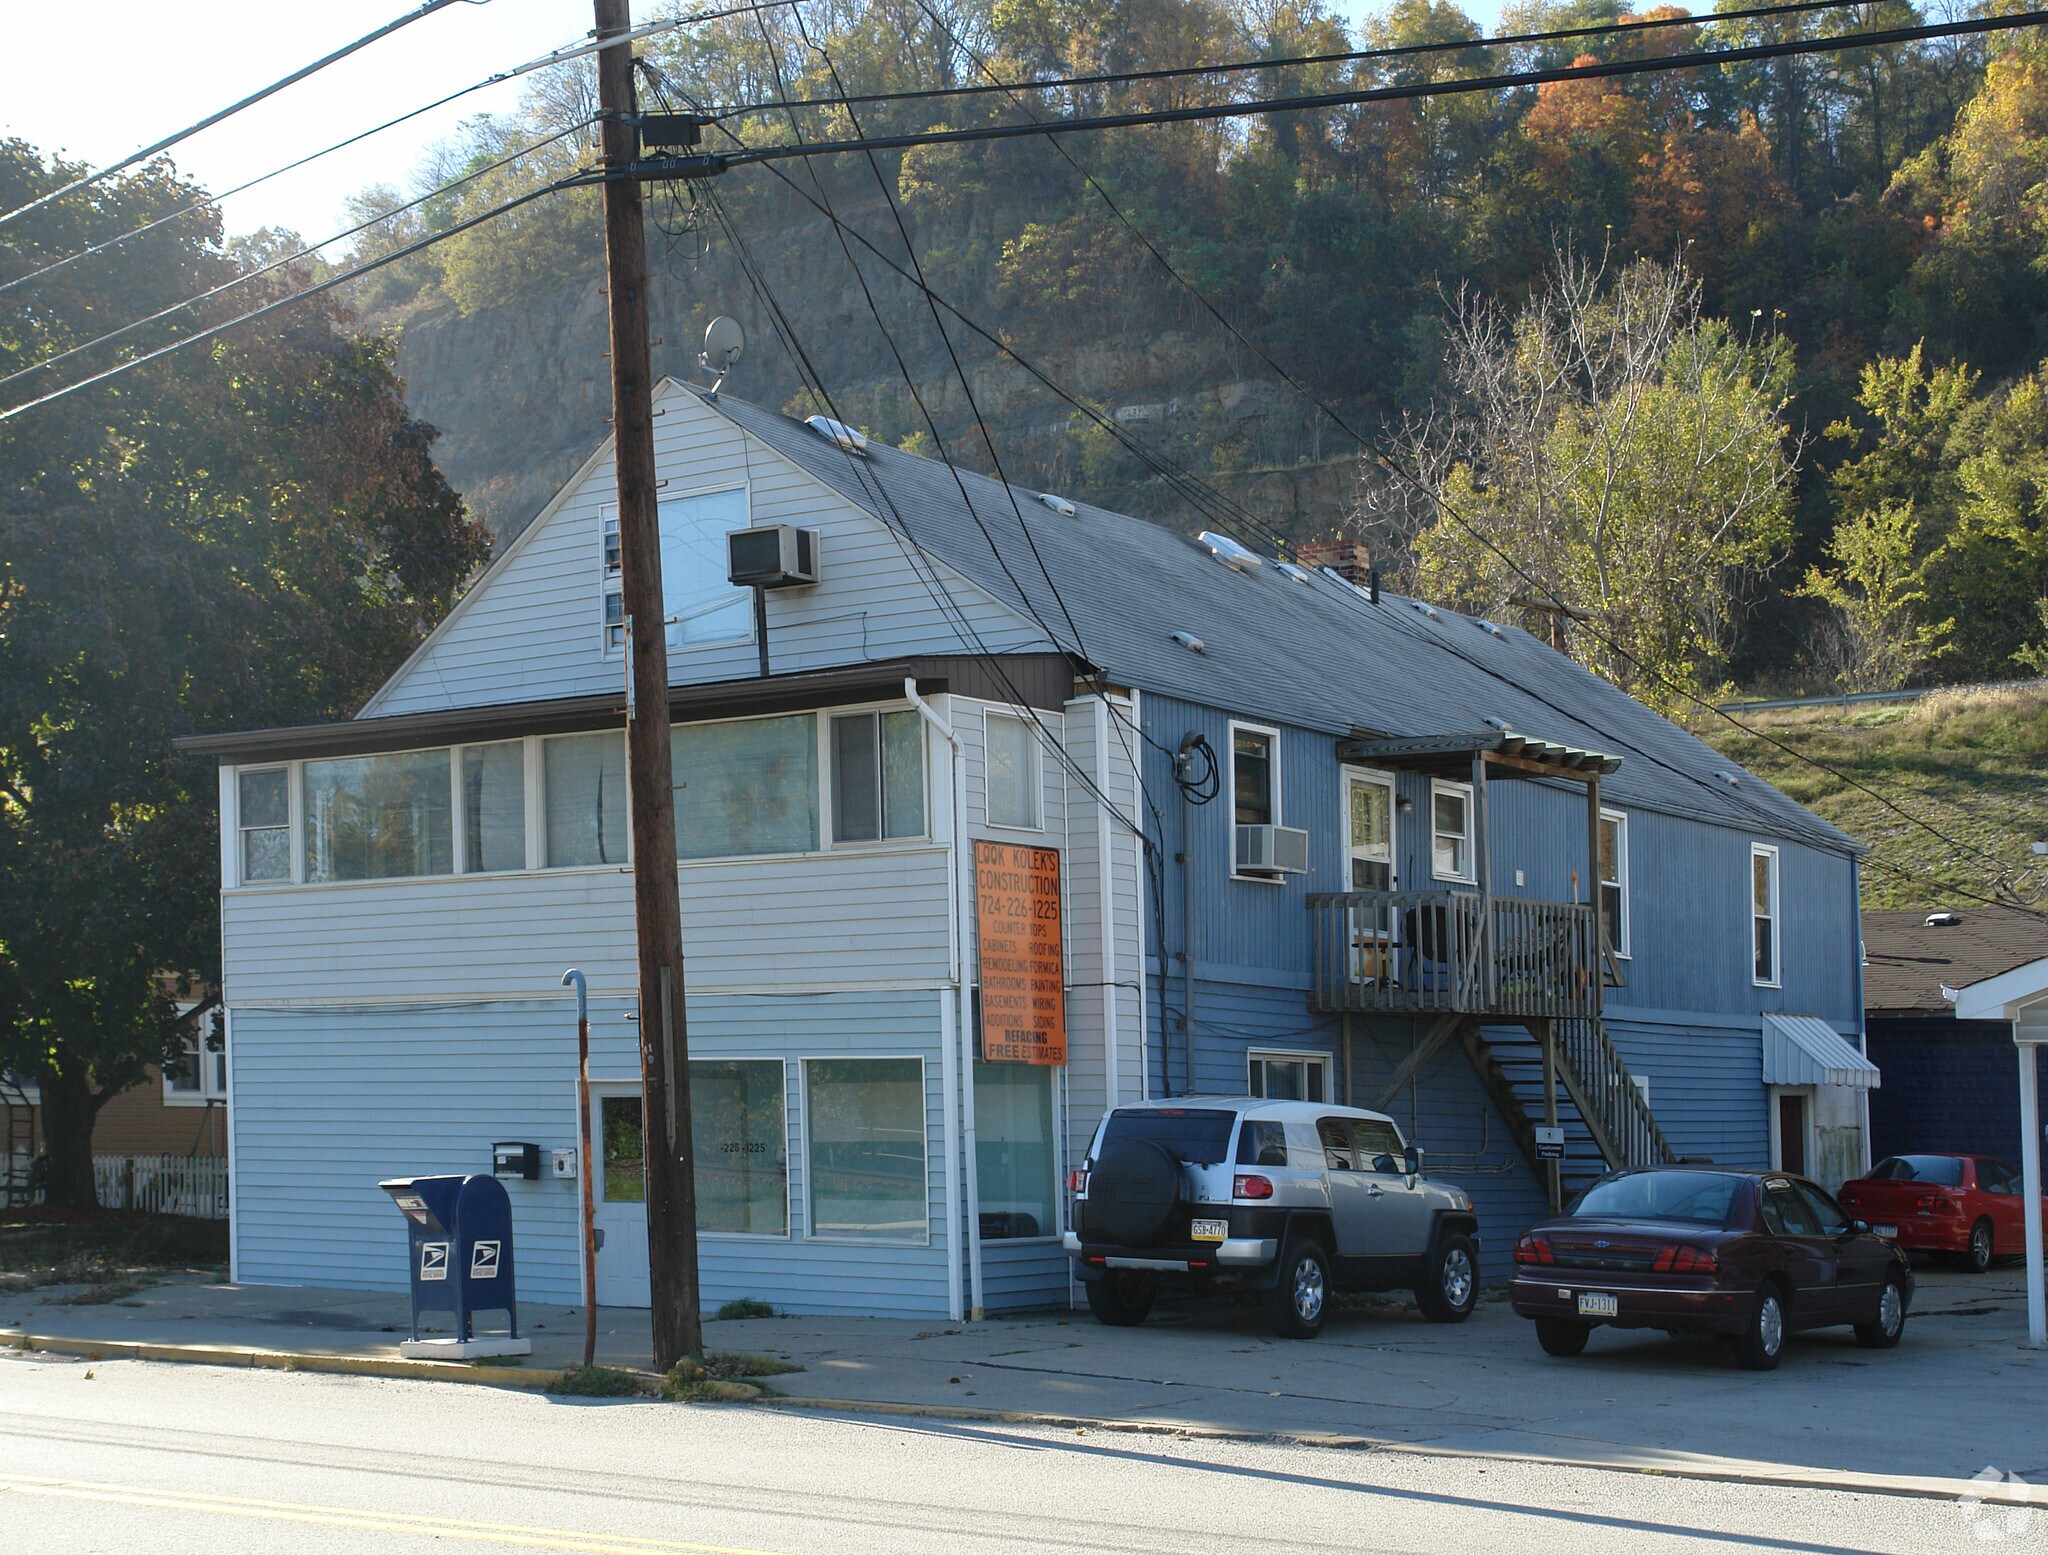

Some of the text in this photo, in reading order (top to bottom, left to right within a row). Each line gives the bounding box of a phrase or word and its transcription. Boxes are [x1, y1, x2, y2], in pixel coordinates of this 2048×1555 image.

[977, 845, 1056, 872] LOOK KOLEK'S
[979, 869, 1058, 896] CONSTRUCTION
[980, 894, 1058, 920] 724-226-1225
[993, 920, 1047, 938] COUNTER TOPS
[982, 937, 1060, 957] CABINETS ROOFING
[982, 957, 1060, 975] REMODELING FORMICA
[983, 976, 1061, 994] BATHROOMS PAINTING
[984, 994, 1056, 1011] BASEMENTS WIRING
[986, 1013, 1055, 1030] ADDITIONS SIDING
[1005, 1029, 1048, 1044] REFACING
[989, 1043, 1063, 1060] FREE ESTIMATES
